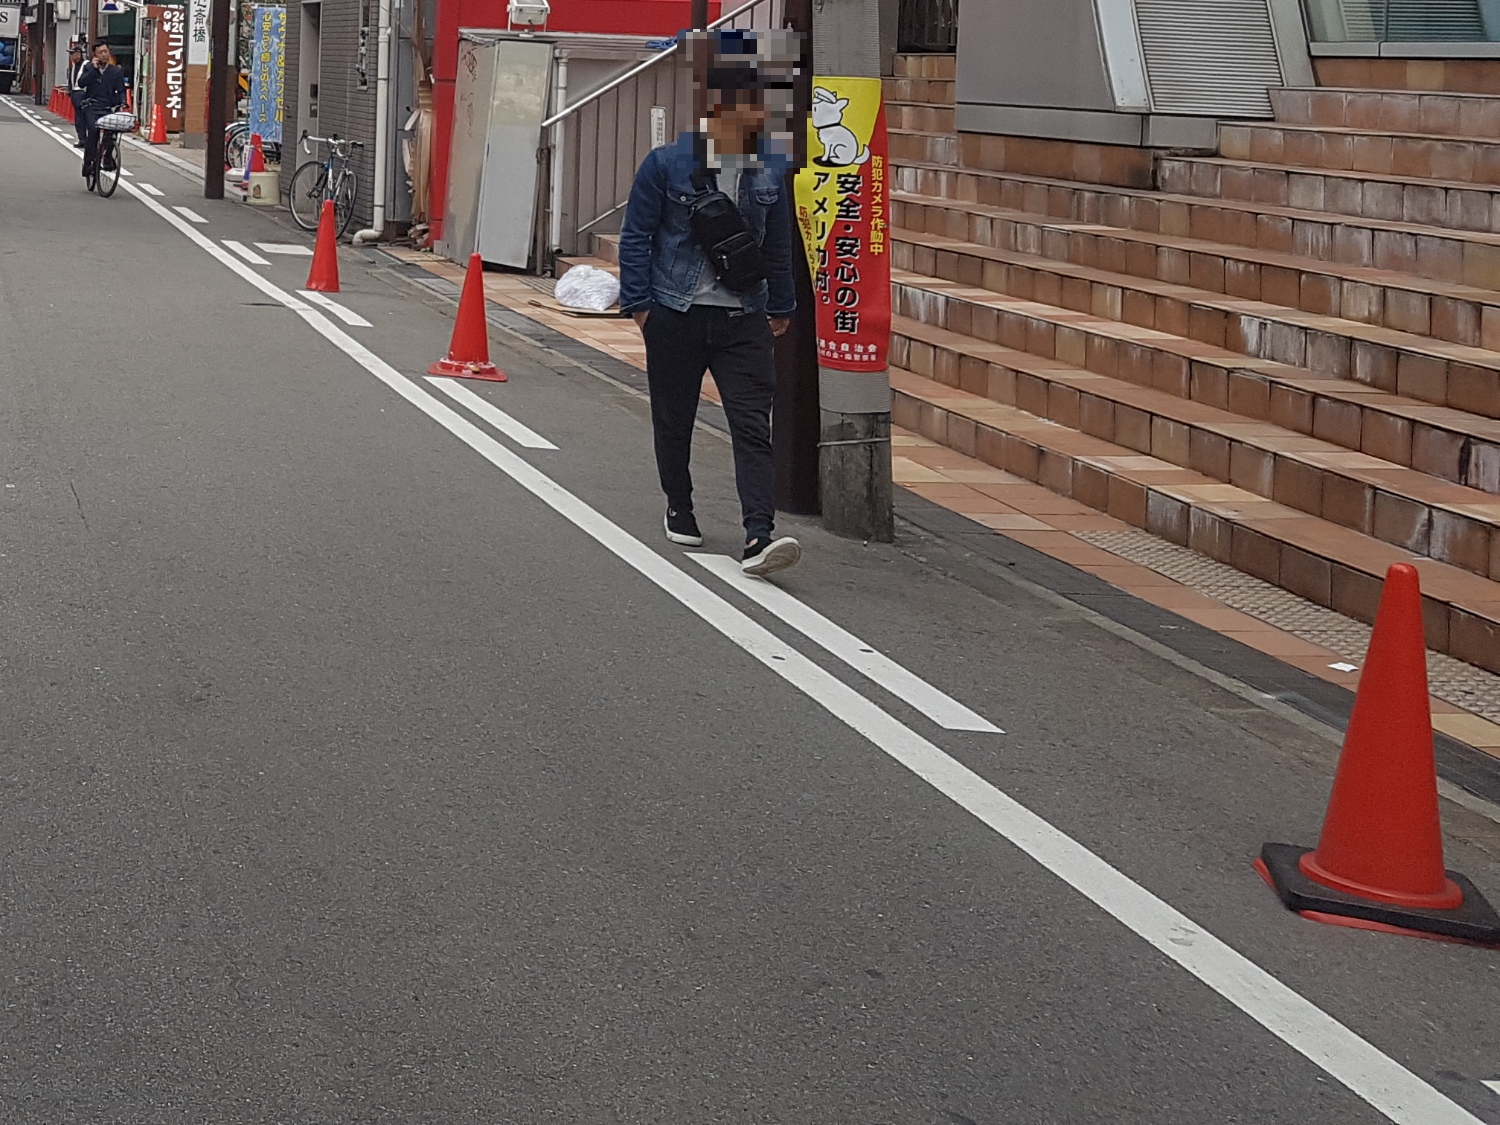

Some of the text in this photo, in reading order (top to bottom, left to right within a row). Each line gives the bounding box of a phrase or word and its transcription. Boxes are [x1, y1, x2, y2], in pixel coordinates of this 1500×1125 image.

[165, 34, 184, 119] コインロッカー
[833, 173, 863, 335] 安全・安心の街
[869, 155, 884, 256] 防犯カメラ作動中
